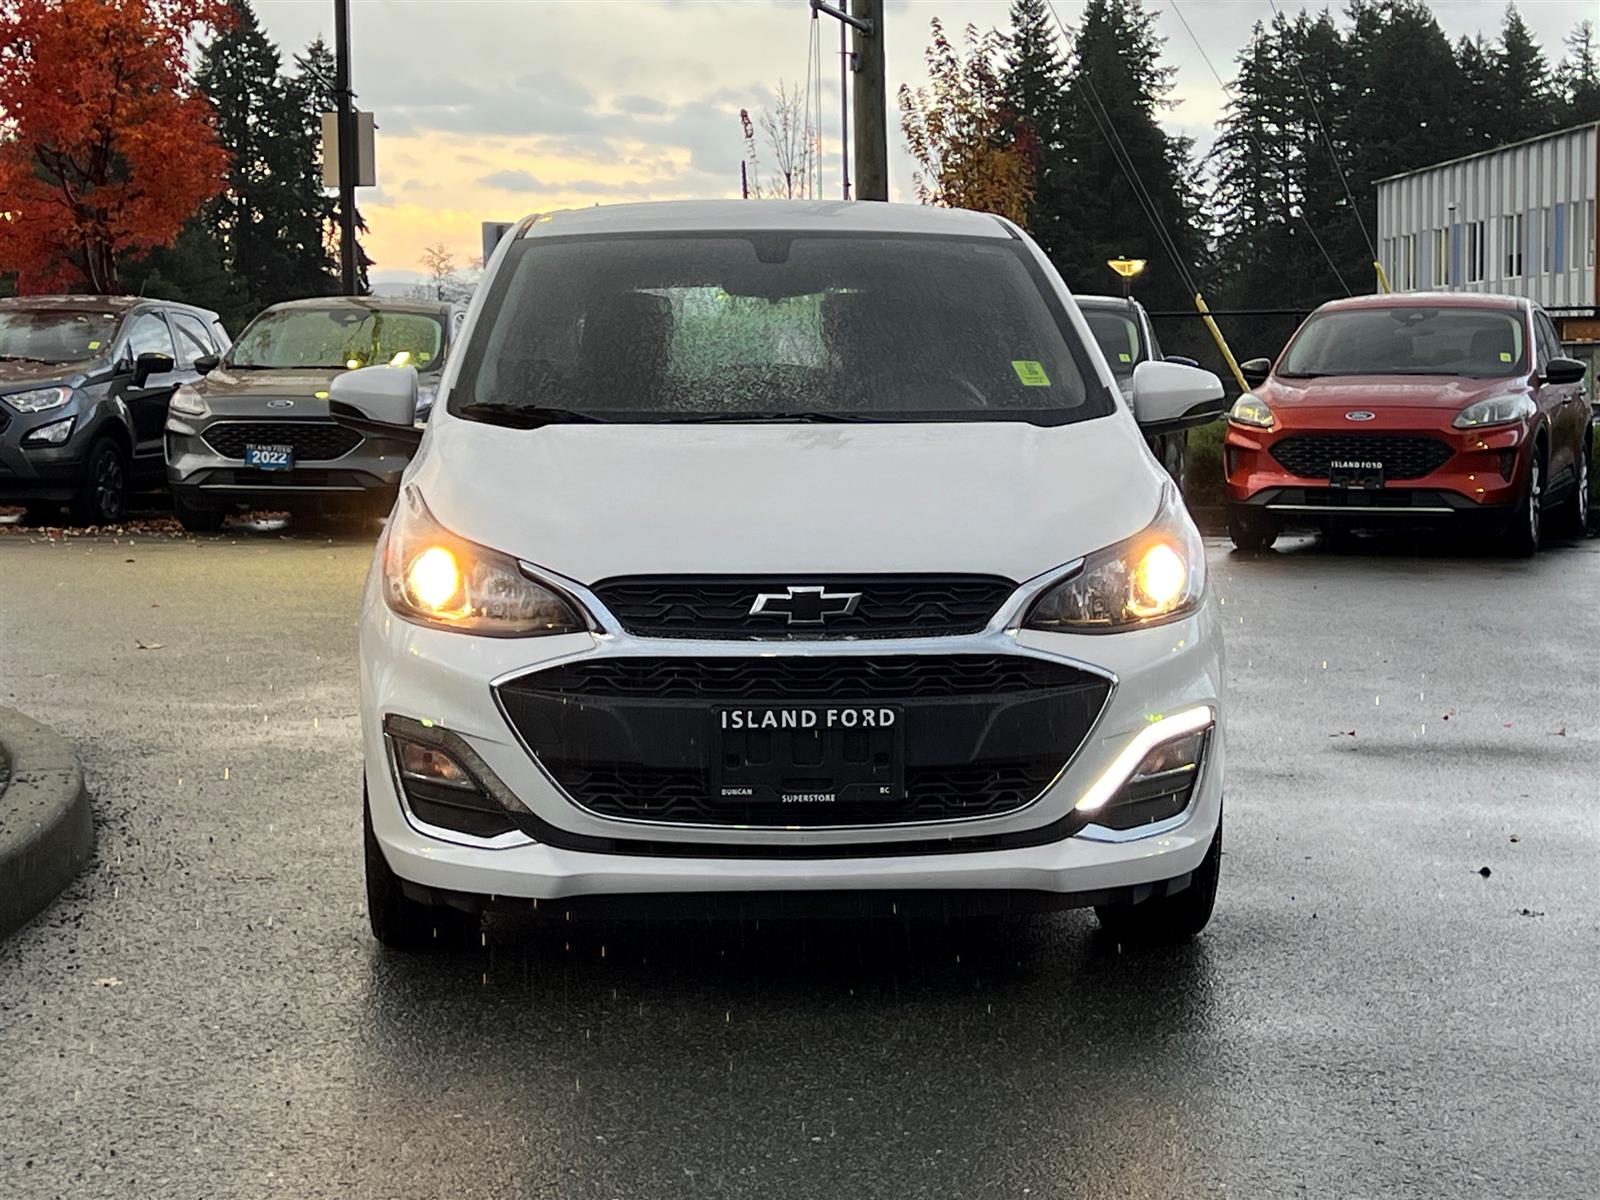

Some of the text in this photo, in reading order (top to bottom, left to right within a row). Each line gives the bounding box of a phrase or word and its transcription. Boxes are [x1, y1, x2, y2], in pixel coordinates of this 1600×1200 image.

[252, 450, 288, 464] 2022
[1331, 461, 1360, 469] ISLAND
[721, 708, 895, 729] ISLAND FORD
[721, 787, 753, 796] DUNCAN
[879, 786, 890, 794] BC
[781, 793, 836, 803] SUPERSTORE
